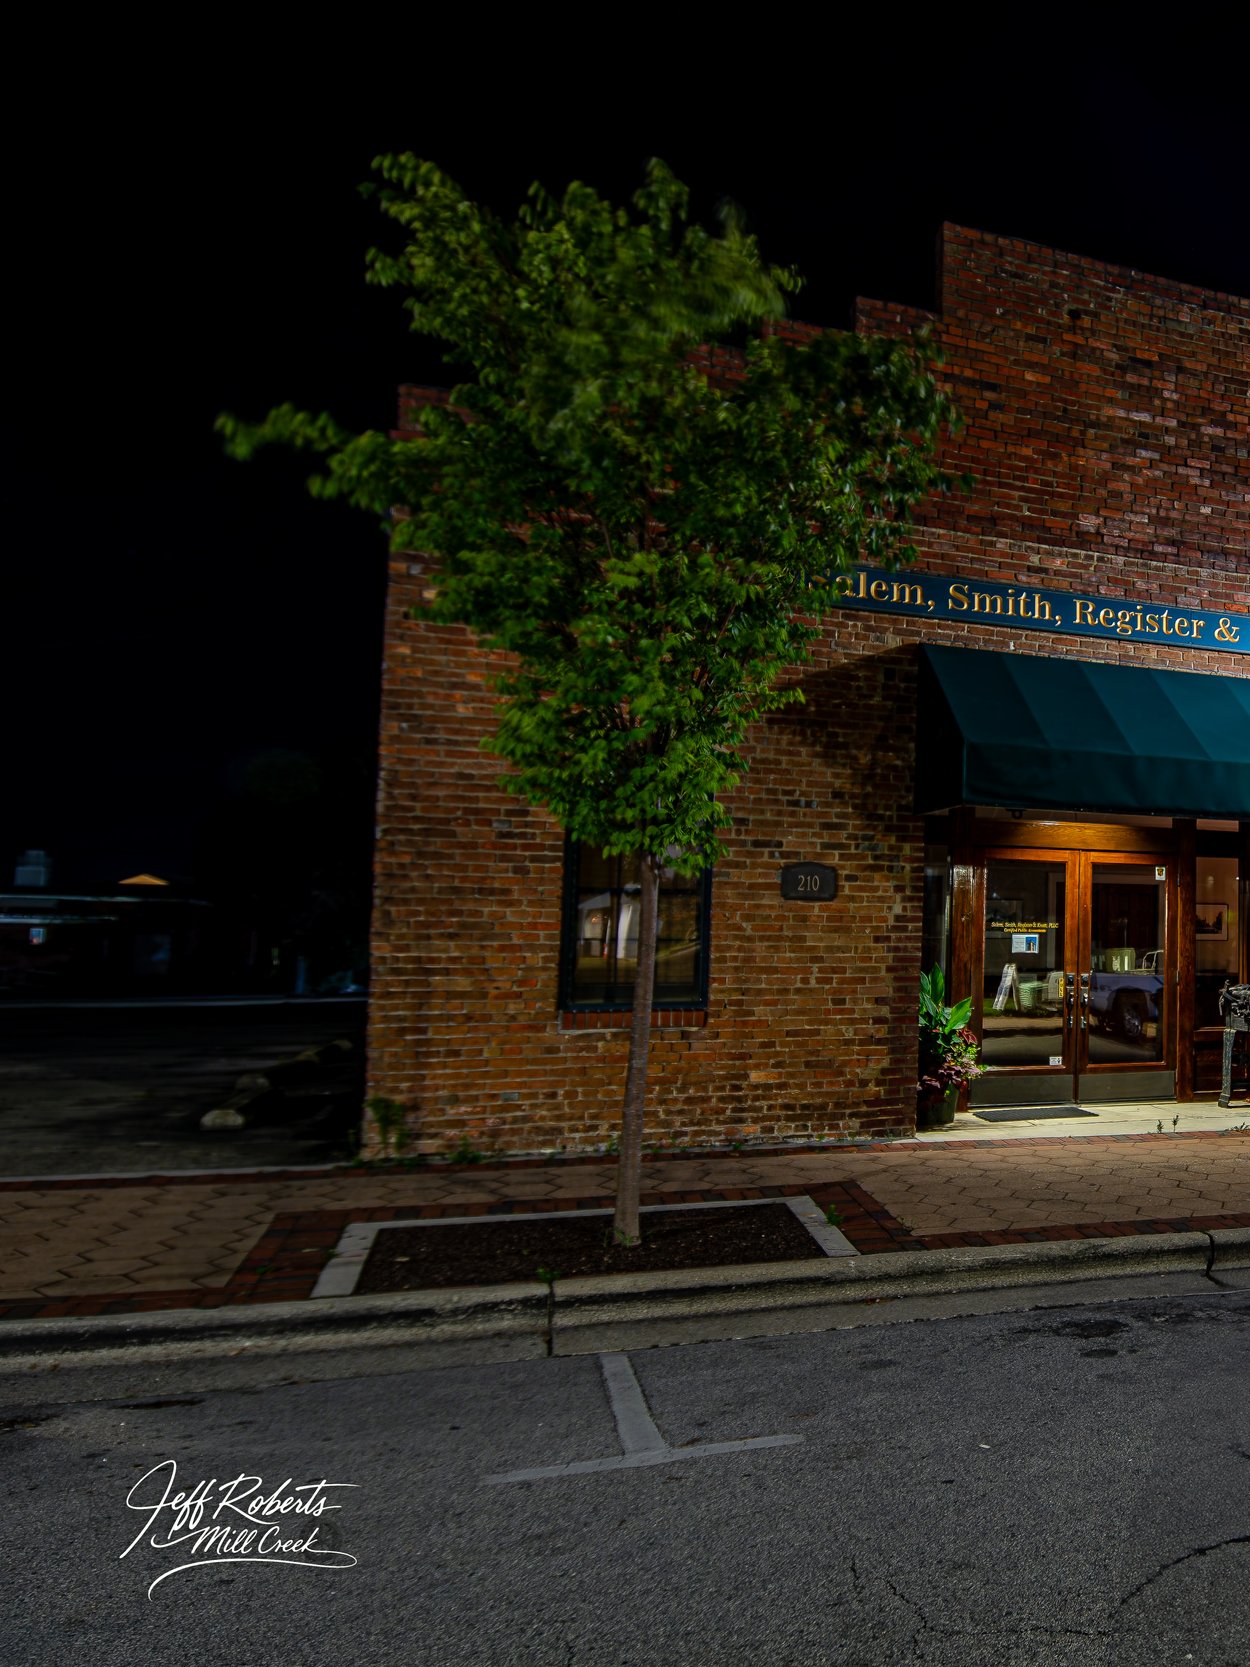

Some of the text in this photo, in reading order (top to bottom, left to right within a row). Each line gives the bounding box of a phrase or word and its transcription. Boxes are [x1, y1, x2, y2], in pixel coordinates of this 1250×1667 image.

[948, 583, 1063, 627] Smith,
[1072, 598, 1206, 639] Register
[1213, 616, 1240, 643] &
[797, 874, 820, 891] 210
